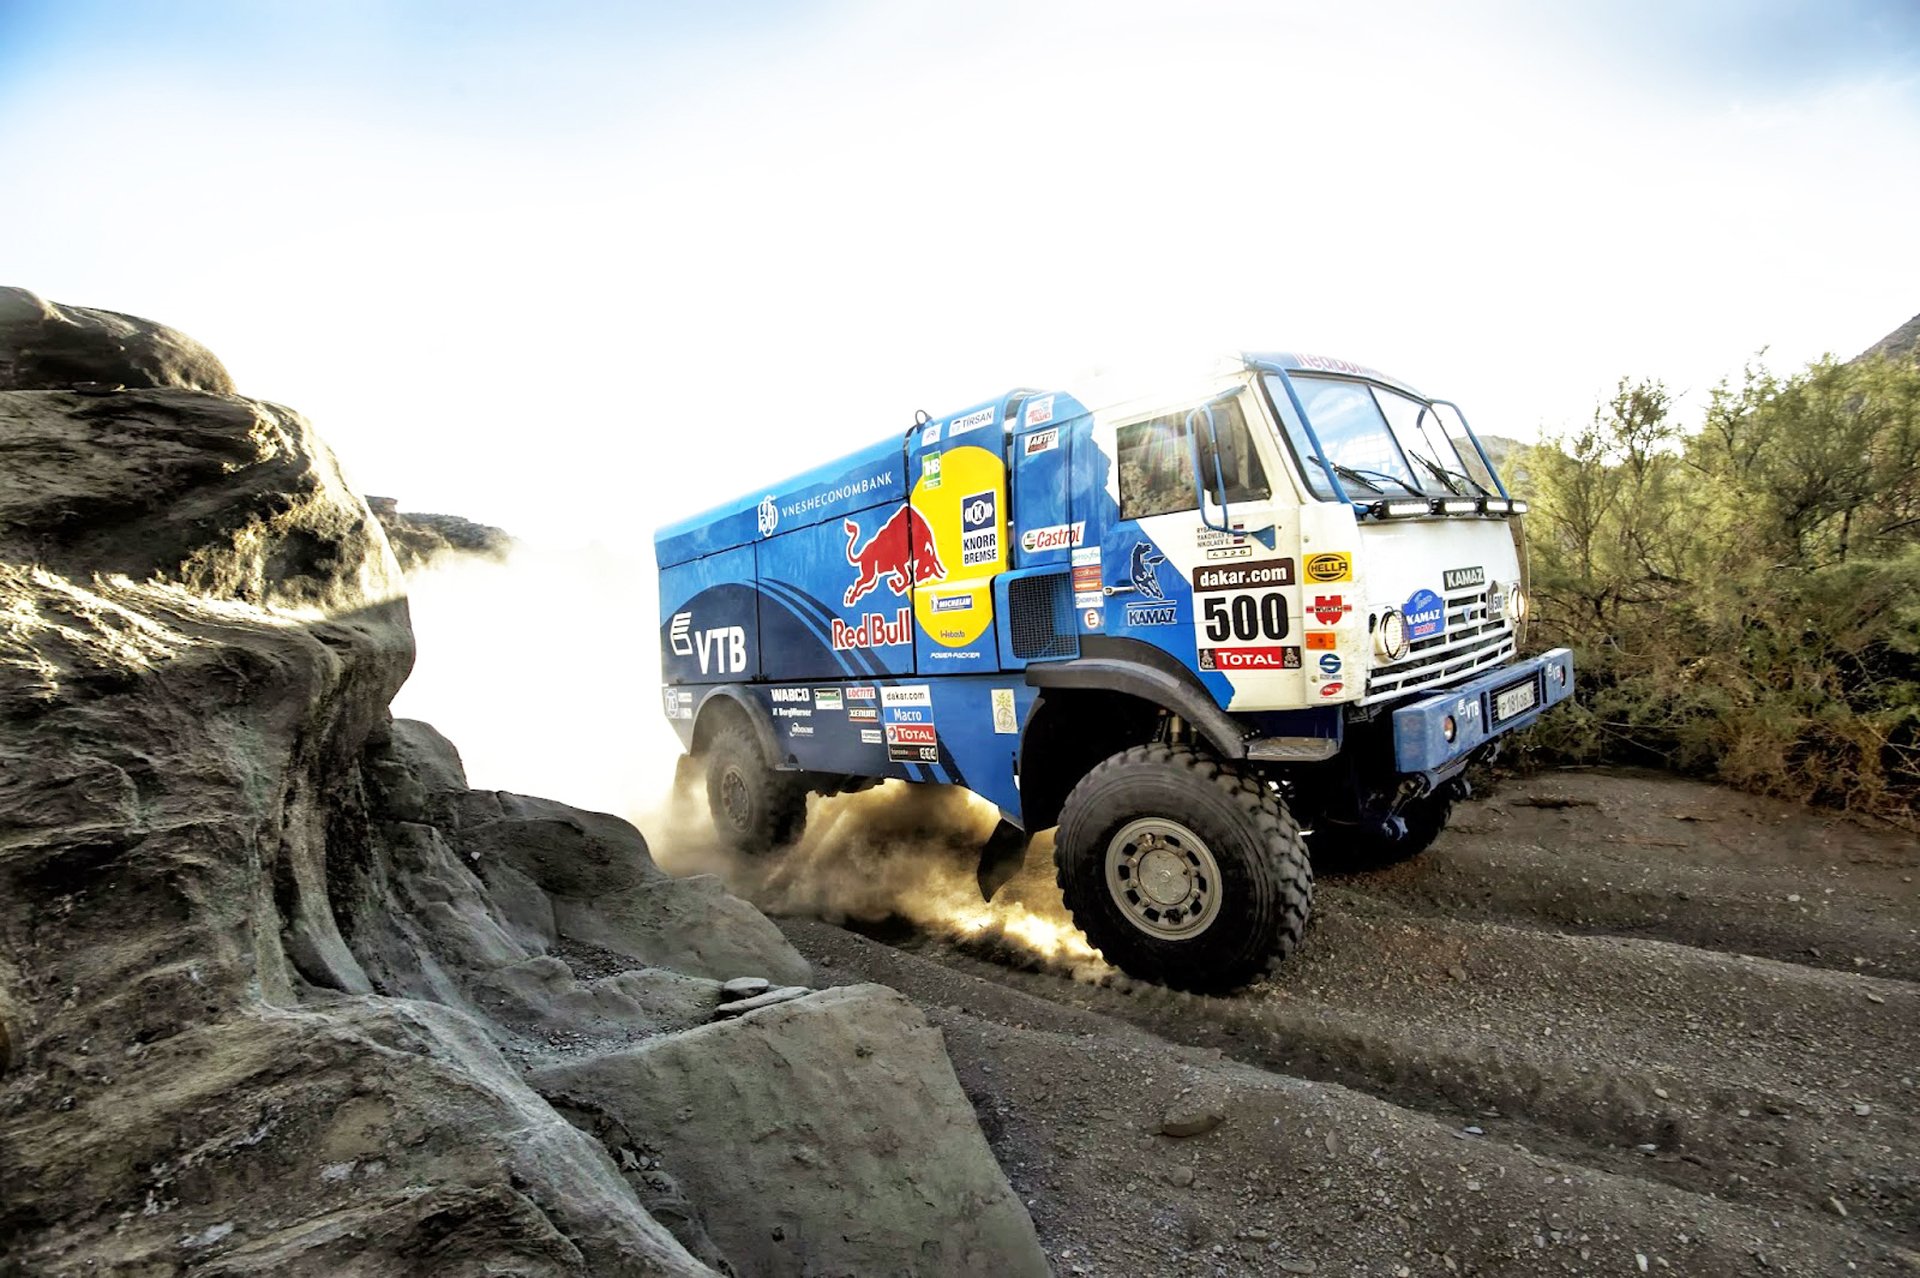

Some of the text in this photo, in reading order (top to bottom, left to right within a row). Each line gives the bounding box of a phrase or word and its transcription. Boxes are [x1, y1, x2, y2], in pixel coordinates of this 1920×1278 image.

[781, 471, 893, 518] VNESHECONOMBANK
[963, 533, 996, 551] KNORR
[1036, 525, 1080, 548] Castrol
[964, 549, 997, 565] BREMSE
[1311, 562, 1348, 573] HELLA
[1200, 567, 1287, 587] dakar.com
[1446, 567, 1485, 588] KAMAZ
[938, 597, 971, 608] MICHELIN
[1129, 609, 1177, 626] KAMAZ
[1204, 593, 1289, 642] 500
[1406, 609, 1441, 626] KAMAZ
[832, 608, 911, 649] Red Bull
[695, 626, 747, 675] VTB
[771, 688, 810, 702] WABCO
[847, 688, 874, 698] LOCTITE
[886, 691, 925, 701] dakar.com
[893, 708, 922, 721] Macro
